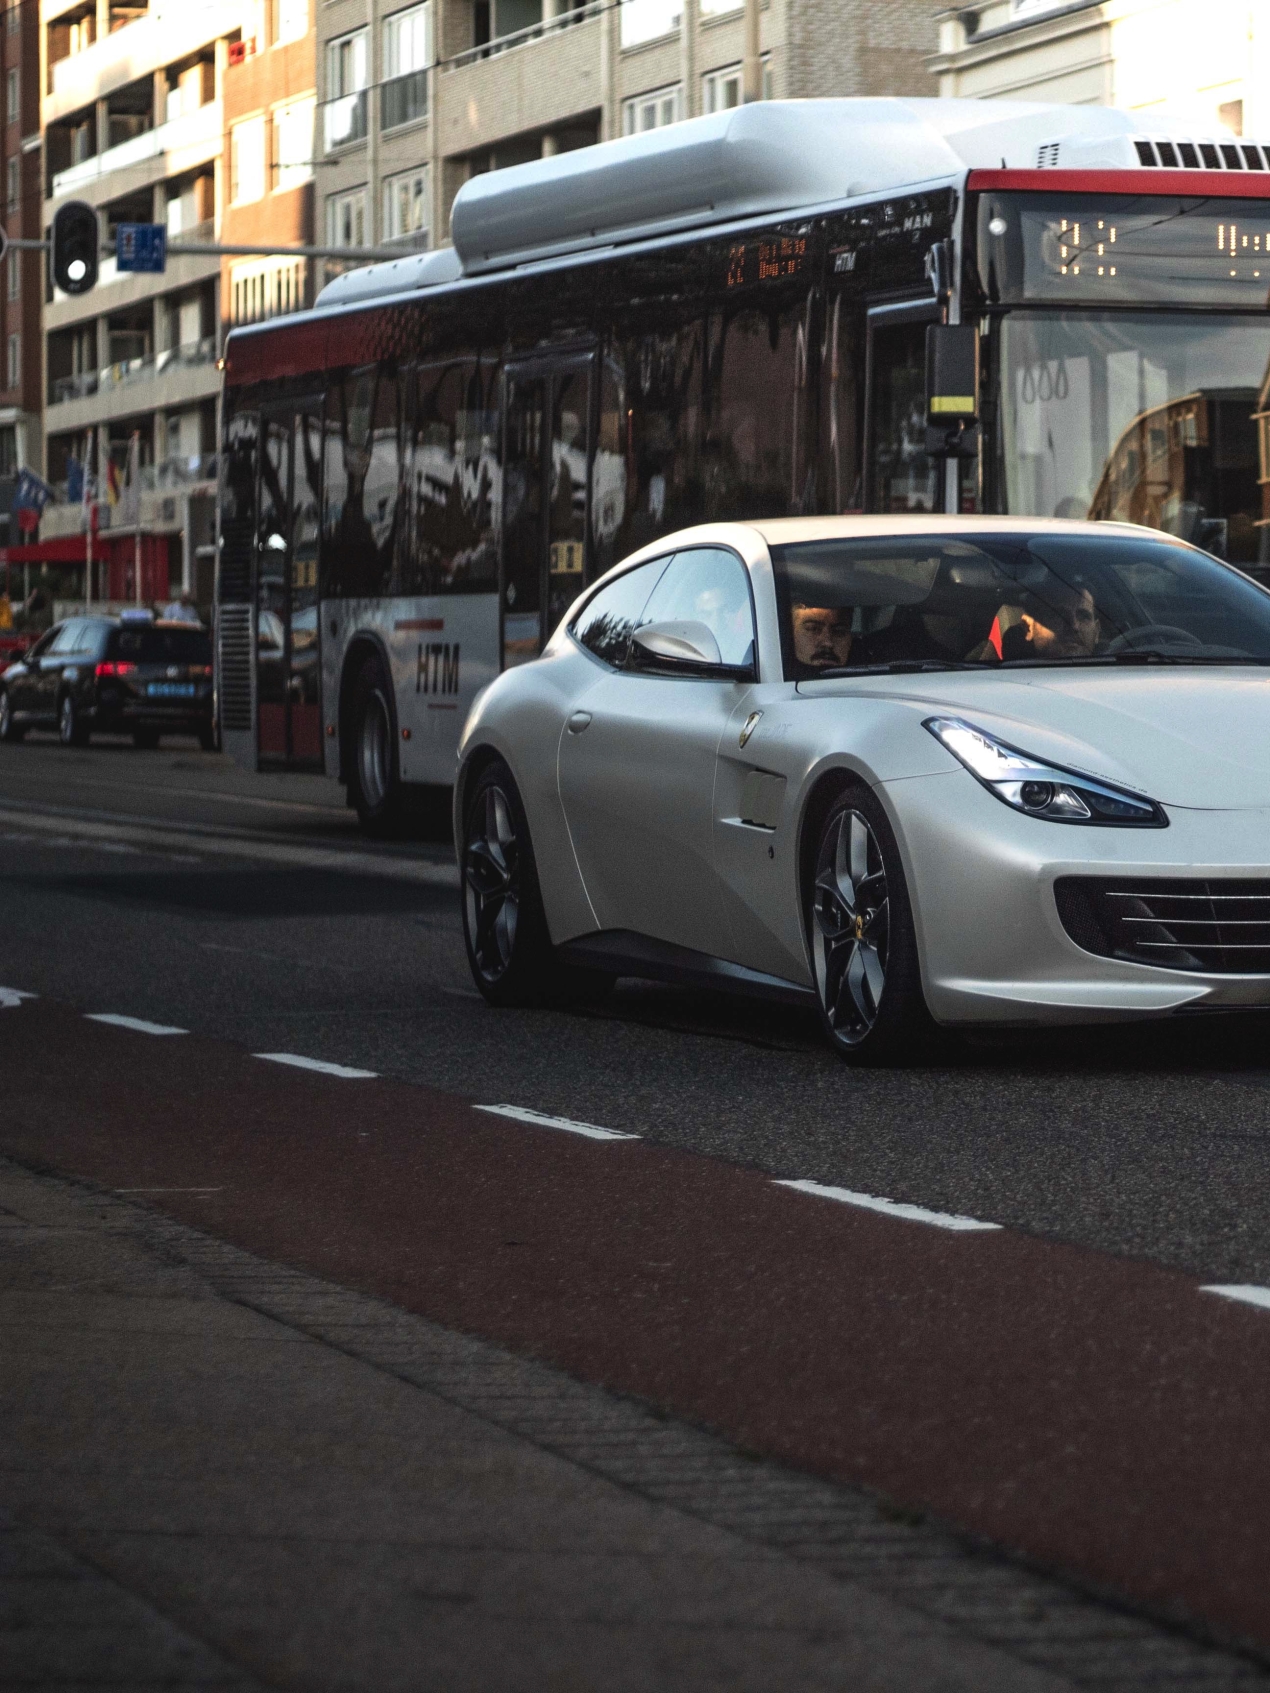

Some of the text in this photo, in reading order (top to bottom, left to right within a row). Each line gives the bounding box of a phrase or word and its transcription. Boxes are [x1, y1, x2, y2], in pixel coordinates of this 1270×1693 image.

[903, 212, 933, 232] MAN
[834, 251, 857, 273] HTM
[416, 643, 460, 694] HTM
